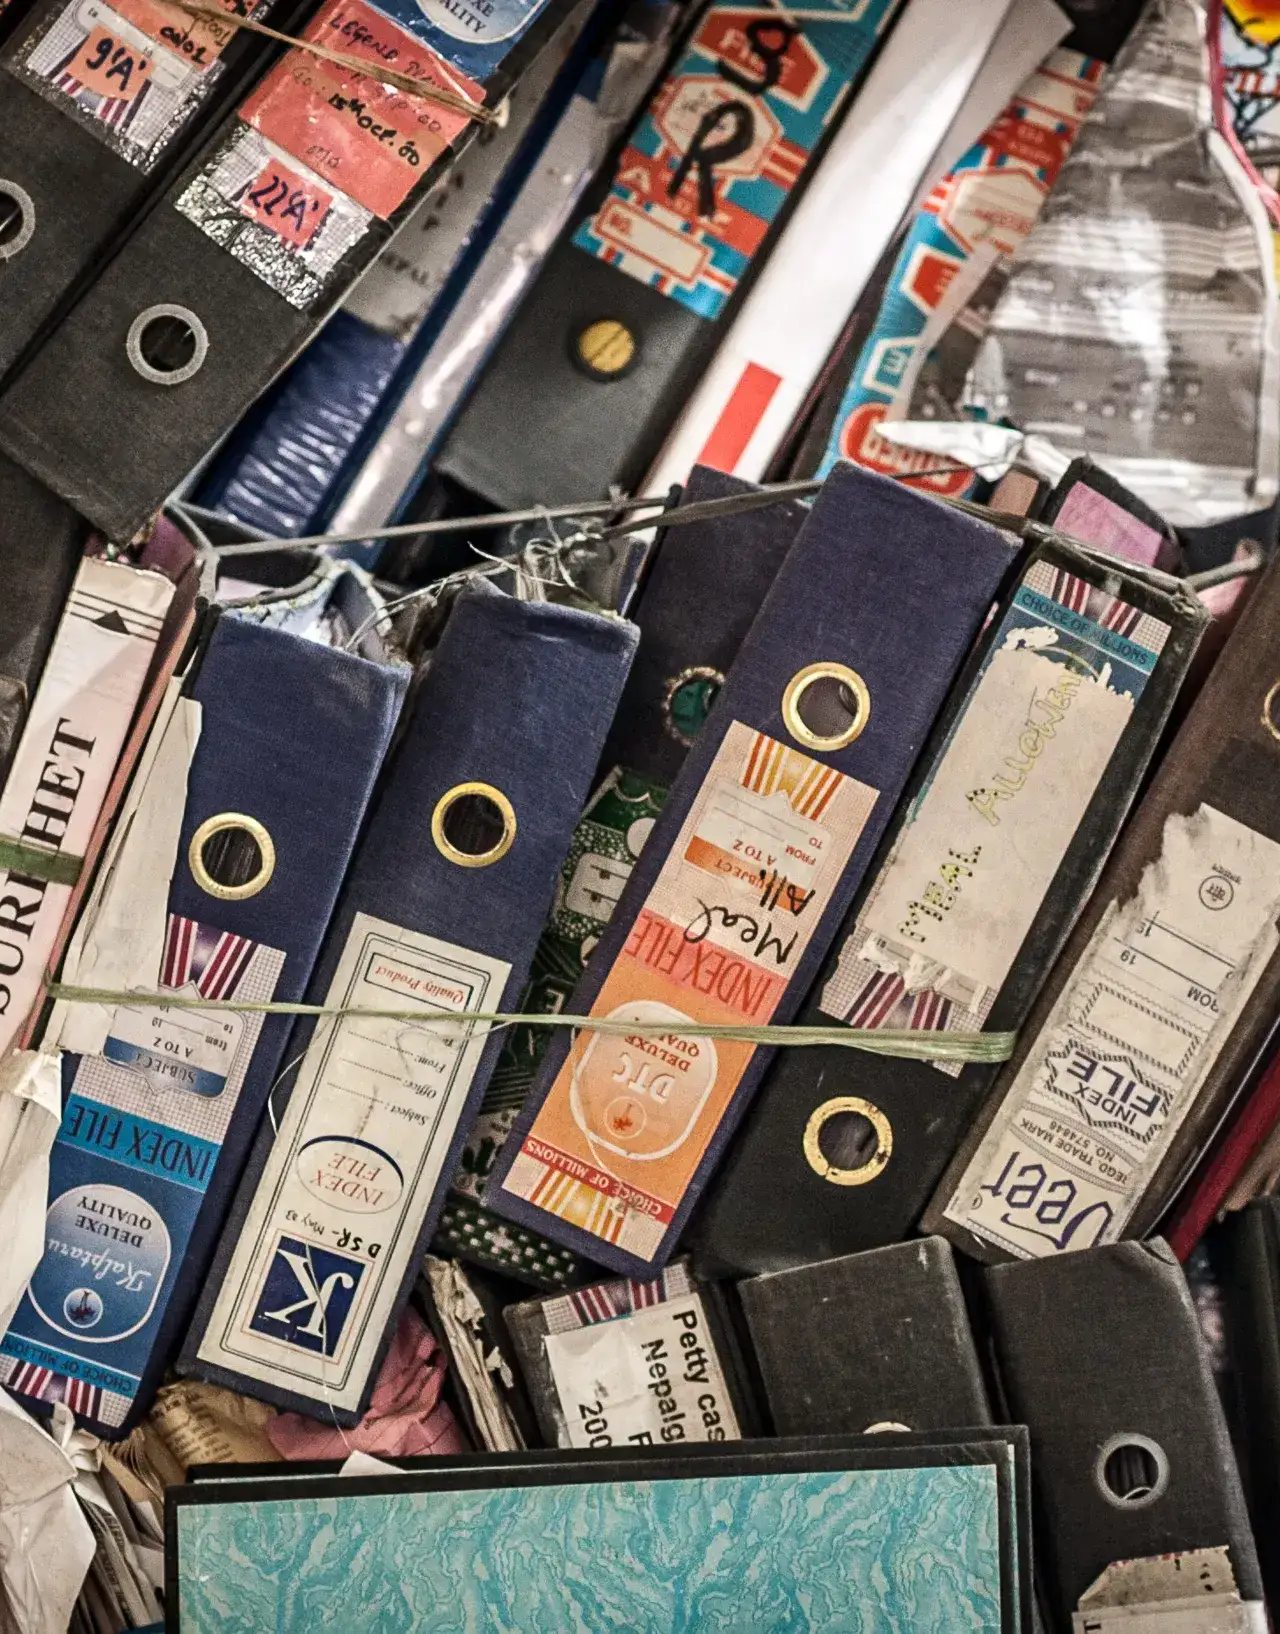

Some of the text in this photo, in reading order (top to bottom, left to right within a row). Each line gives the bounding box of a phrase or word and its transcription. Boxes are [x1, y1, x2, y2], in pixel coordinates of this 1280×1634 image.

[667, 100, 755, 221] R
[732, 839, 777, 866] A TO Z
[785, 844, 816, 866] FROM
[808, 836, 823, 850] TO
[373, 962, 466, 1008] Quality Product
[623, 912, 772, 1017] INDEX FILE
[624, 1035, 691, 1073] DELUXE
[612, 1052, 676, 1105] DTC
[1066, 1050, 1163, 1118] FILE
[1075, 1082, 1139, 1126] INDEX
[64, 1102, 210, 1182] INDEX FILE
[527, 1141, 589, 1179] MILLIONS
[1019, 1118, 1094, 1166] TRADE MARK
[328, 1150, 385, 1179] FILE
[590, 1173, 610, 1189] OF
[308, 1170, 386, 1208] INDEX
[981, 1150, 1114, 1251] Veer
[73, 1214, 144, 1249] DELUXE
[75, 1194, 152, 1231] QUALITY
[47, 1236, 153, 1294] Kalptaru
[672, 1310, 711, 1387] Petty
